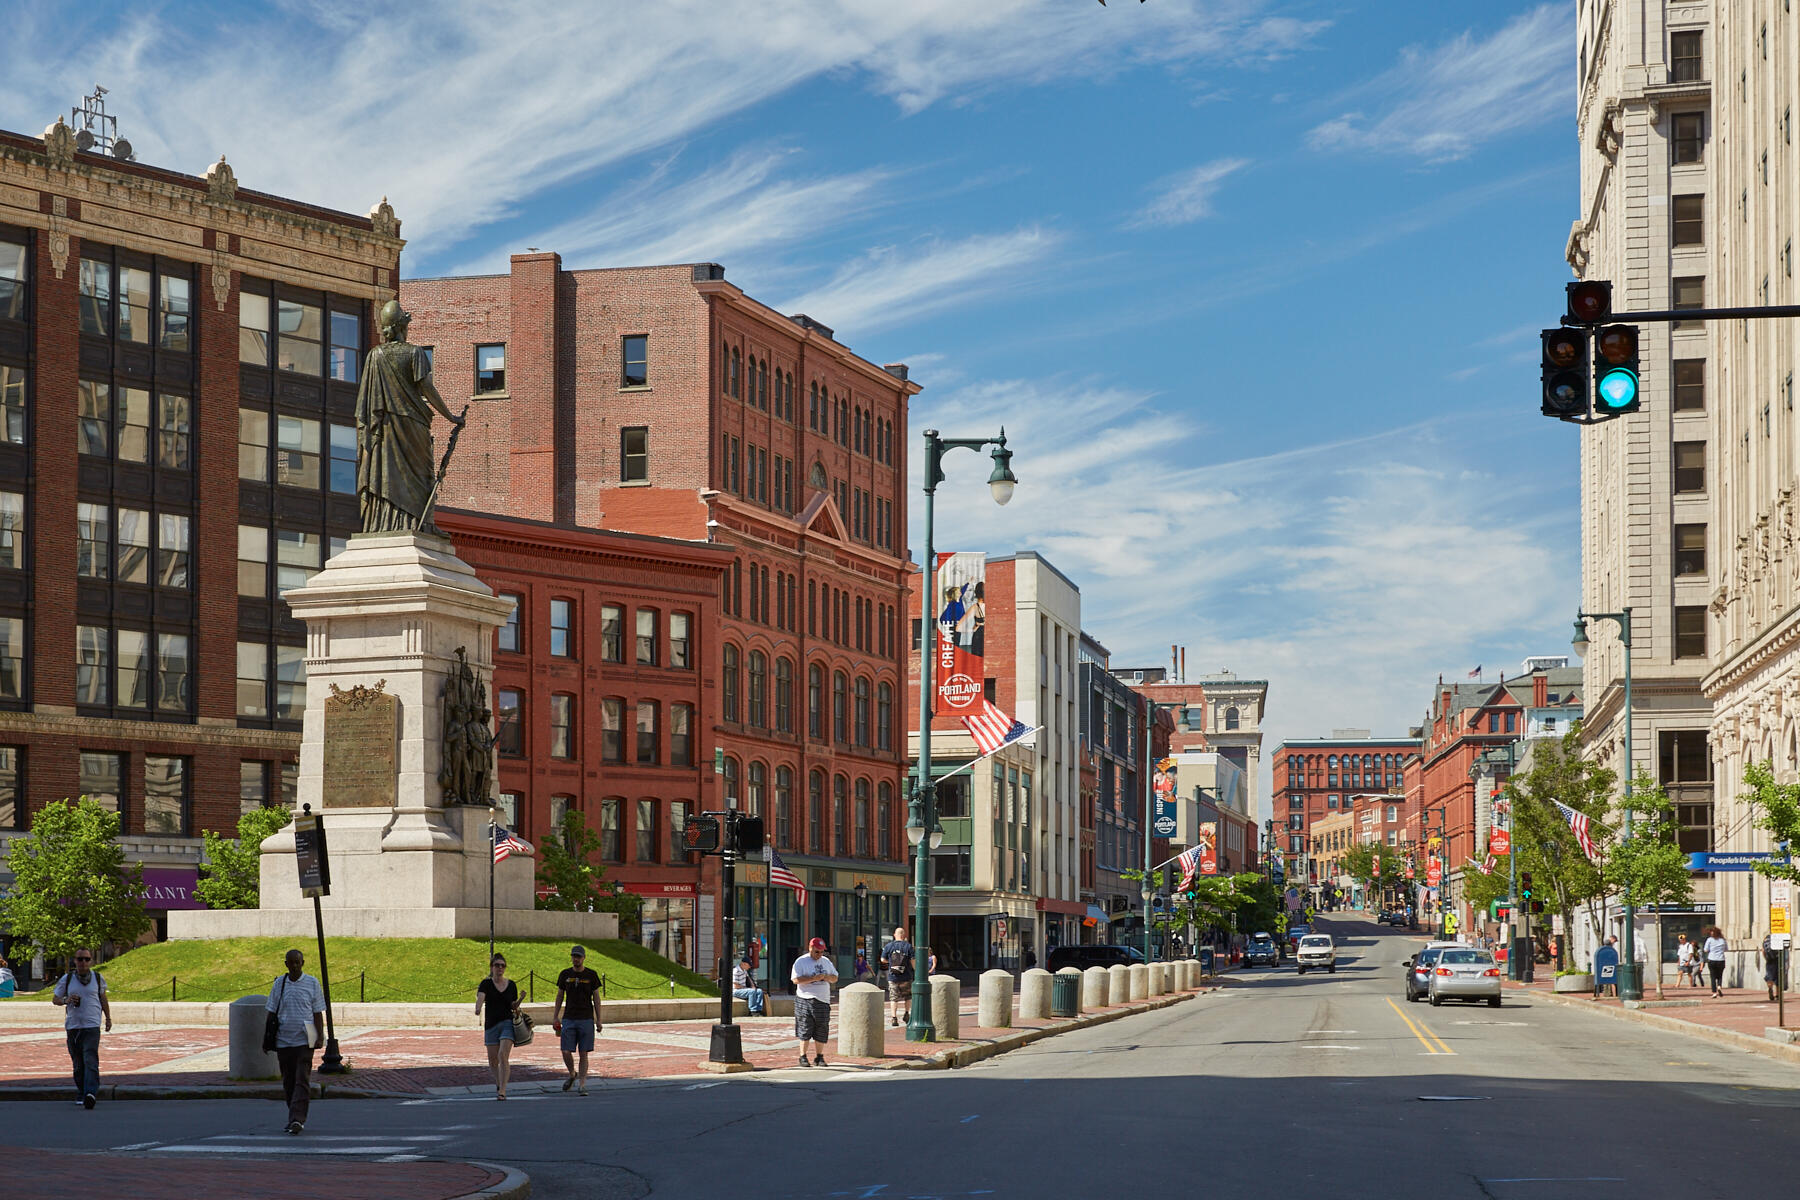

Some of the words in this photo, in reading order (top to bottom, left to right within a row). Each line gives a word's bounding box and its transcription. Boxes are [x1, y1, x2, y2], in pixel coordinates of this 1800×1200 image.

[942, 620, 954, 668] CREATE
[939, 683, 981, 696] PORTLAND
[1156, 789, 1164, 815] INSPIRE
[1708, 857, 1738, 865] People's
